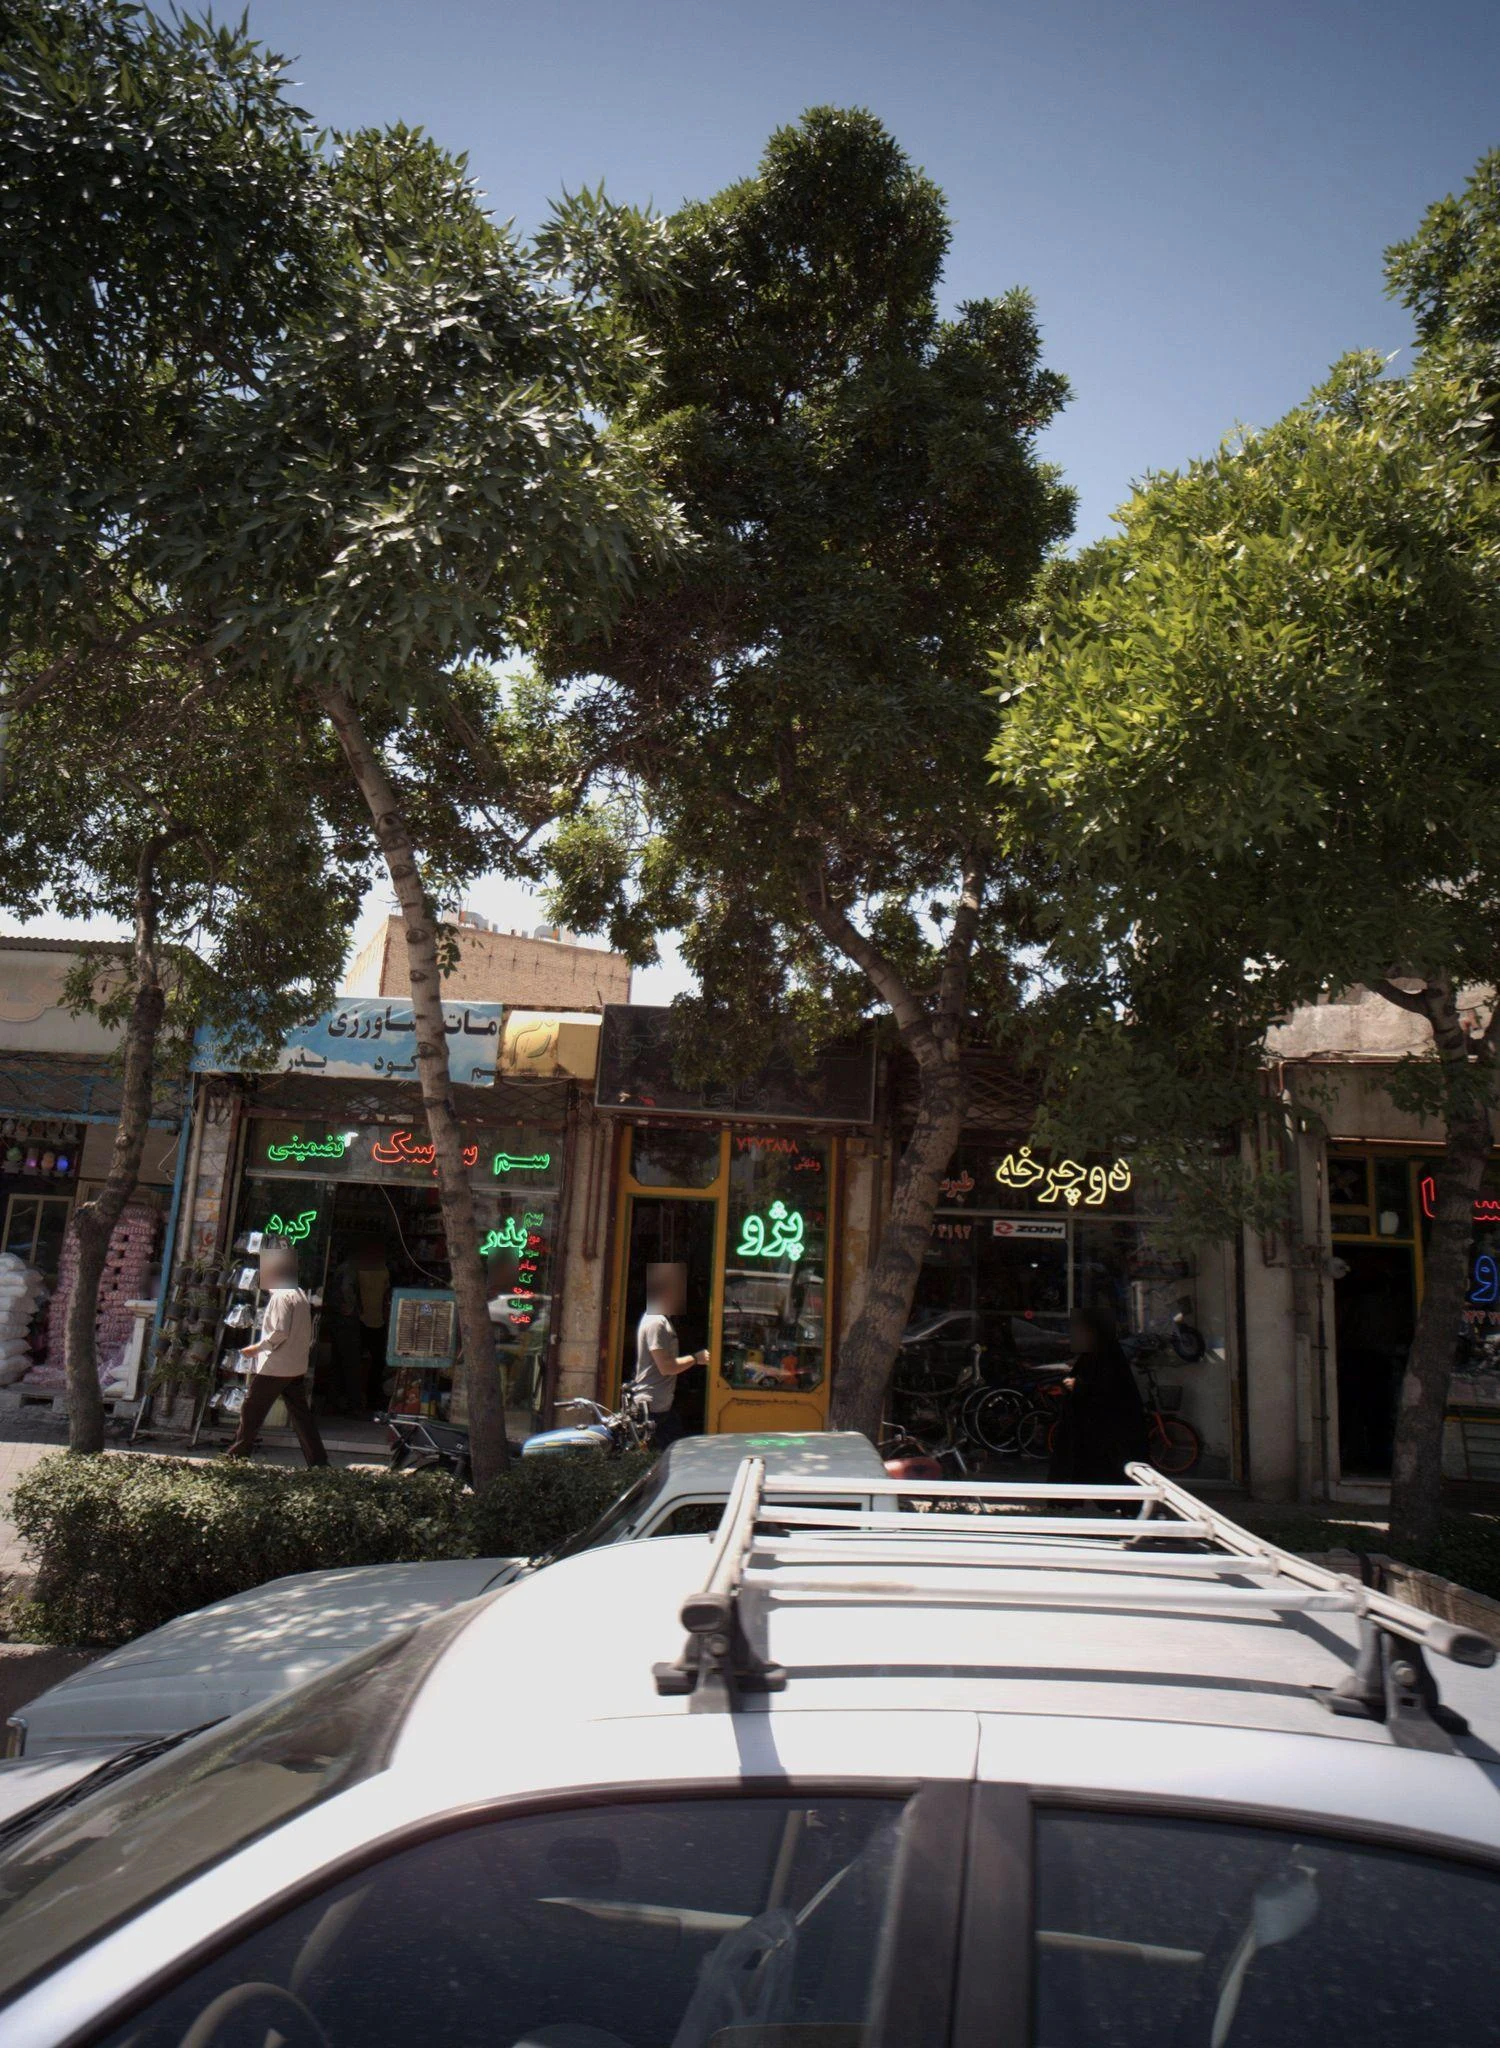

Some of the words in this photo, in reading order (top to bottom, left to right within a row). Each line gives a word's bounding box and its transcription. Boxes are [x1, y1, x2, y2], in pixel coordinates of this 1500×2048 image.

[443, 1009, 498, 1036] مات
[267, 1133, 346, 1162] تضمینی
[493, 1150, 551, 1175] سم
[736, 1200, 804, 1261] پژو
[1016, 1224, 1064, 1235] ZOOM
